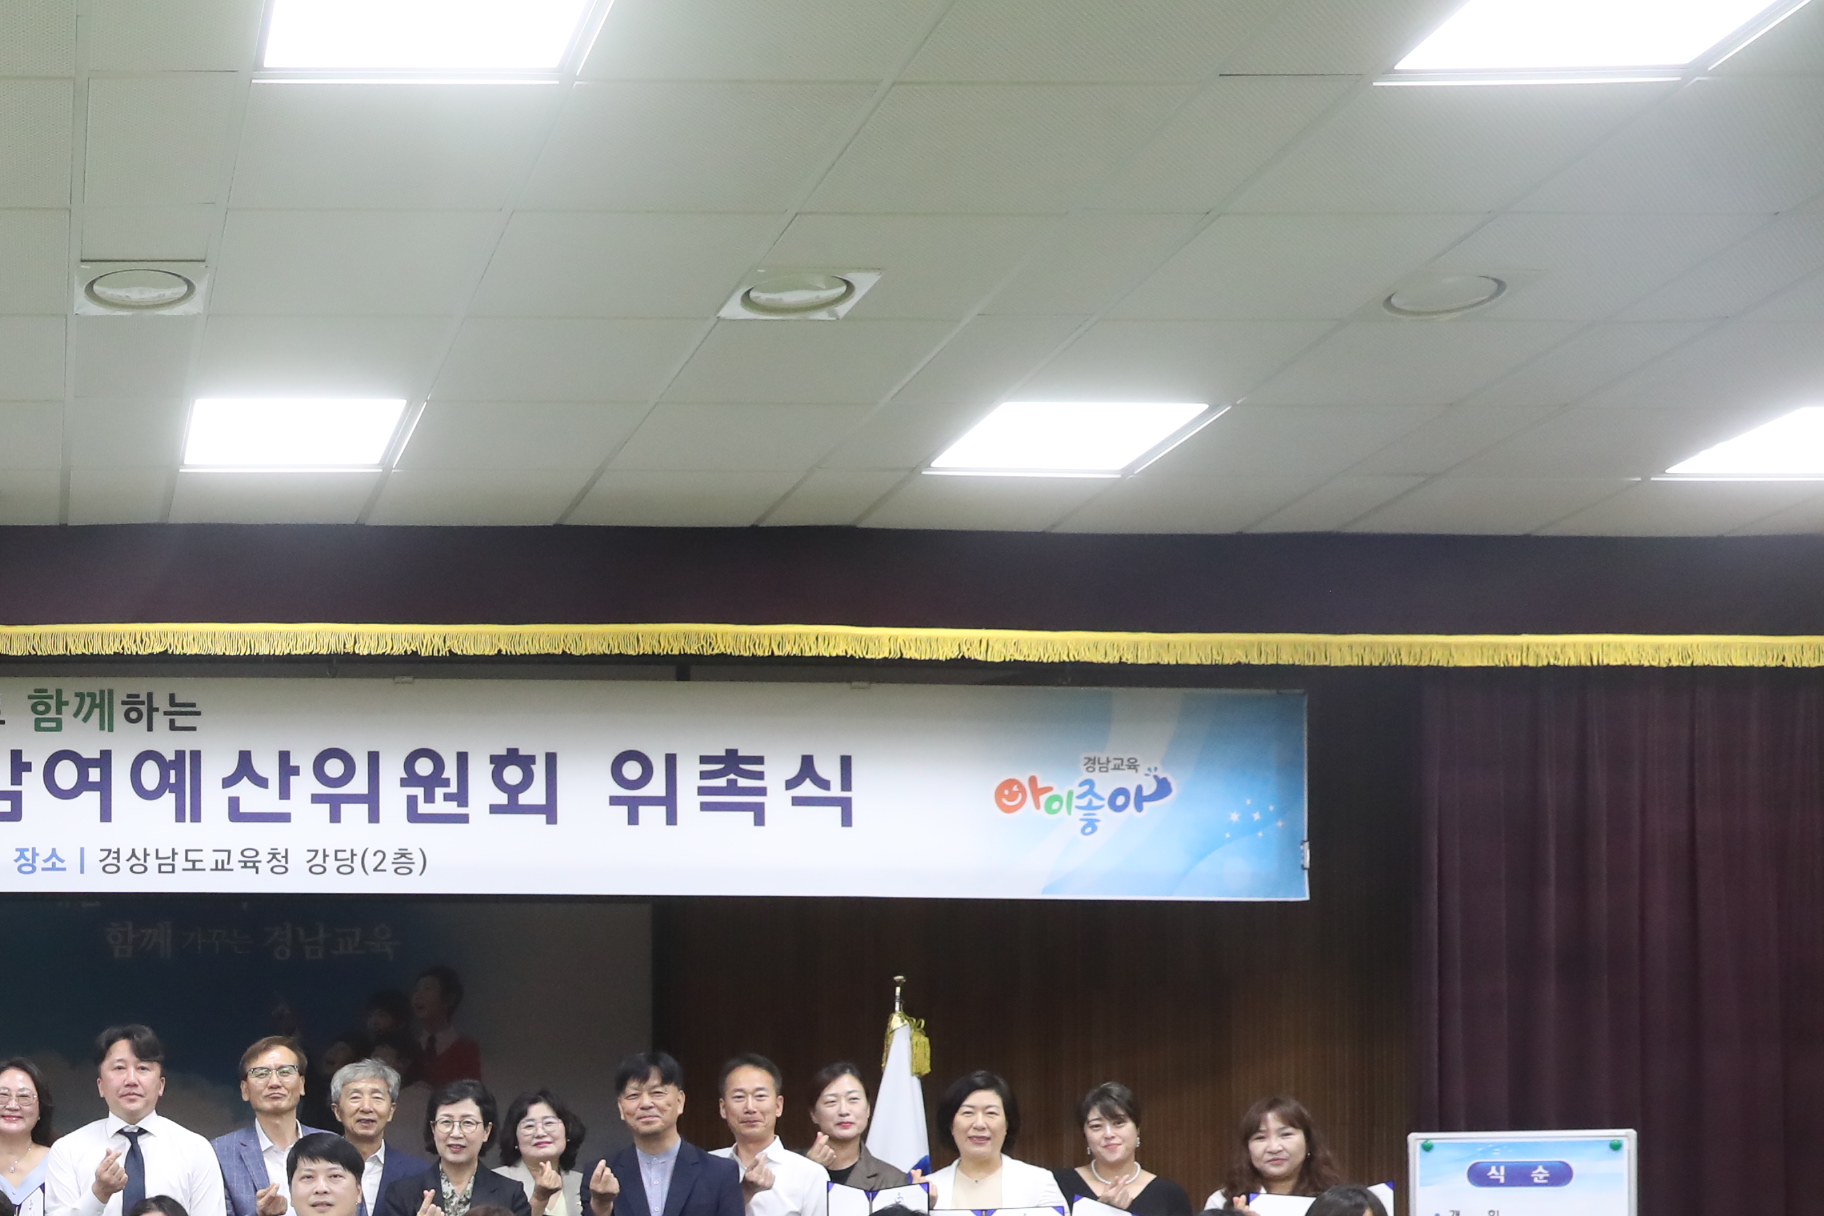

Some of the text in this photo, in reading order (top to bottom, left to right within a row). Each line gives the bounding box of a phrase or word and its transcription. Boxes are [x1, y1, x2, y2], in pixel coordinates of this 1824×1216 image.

[27, 688, 202, 732] 함께하는
[1083, 756, 1140, 773] 경남교육
[608, 748, 854, 828] 위촉식
[994, 775, 1173, 836] 아이좋아
[13, 847, 428, 876] 장소 경상남도교육청 강당(2층)
[104, 921, 172, 960] 함께
[263, 921, 401, 961] 경남교육
